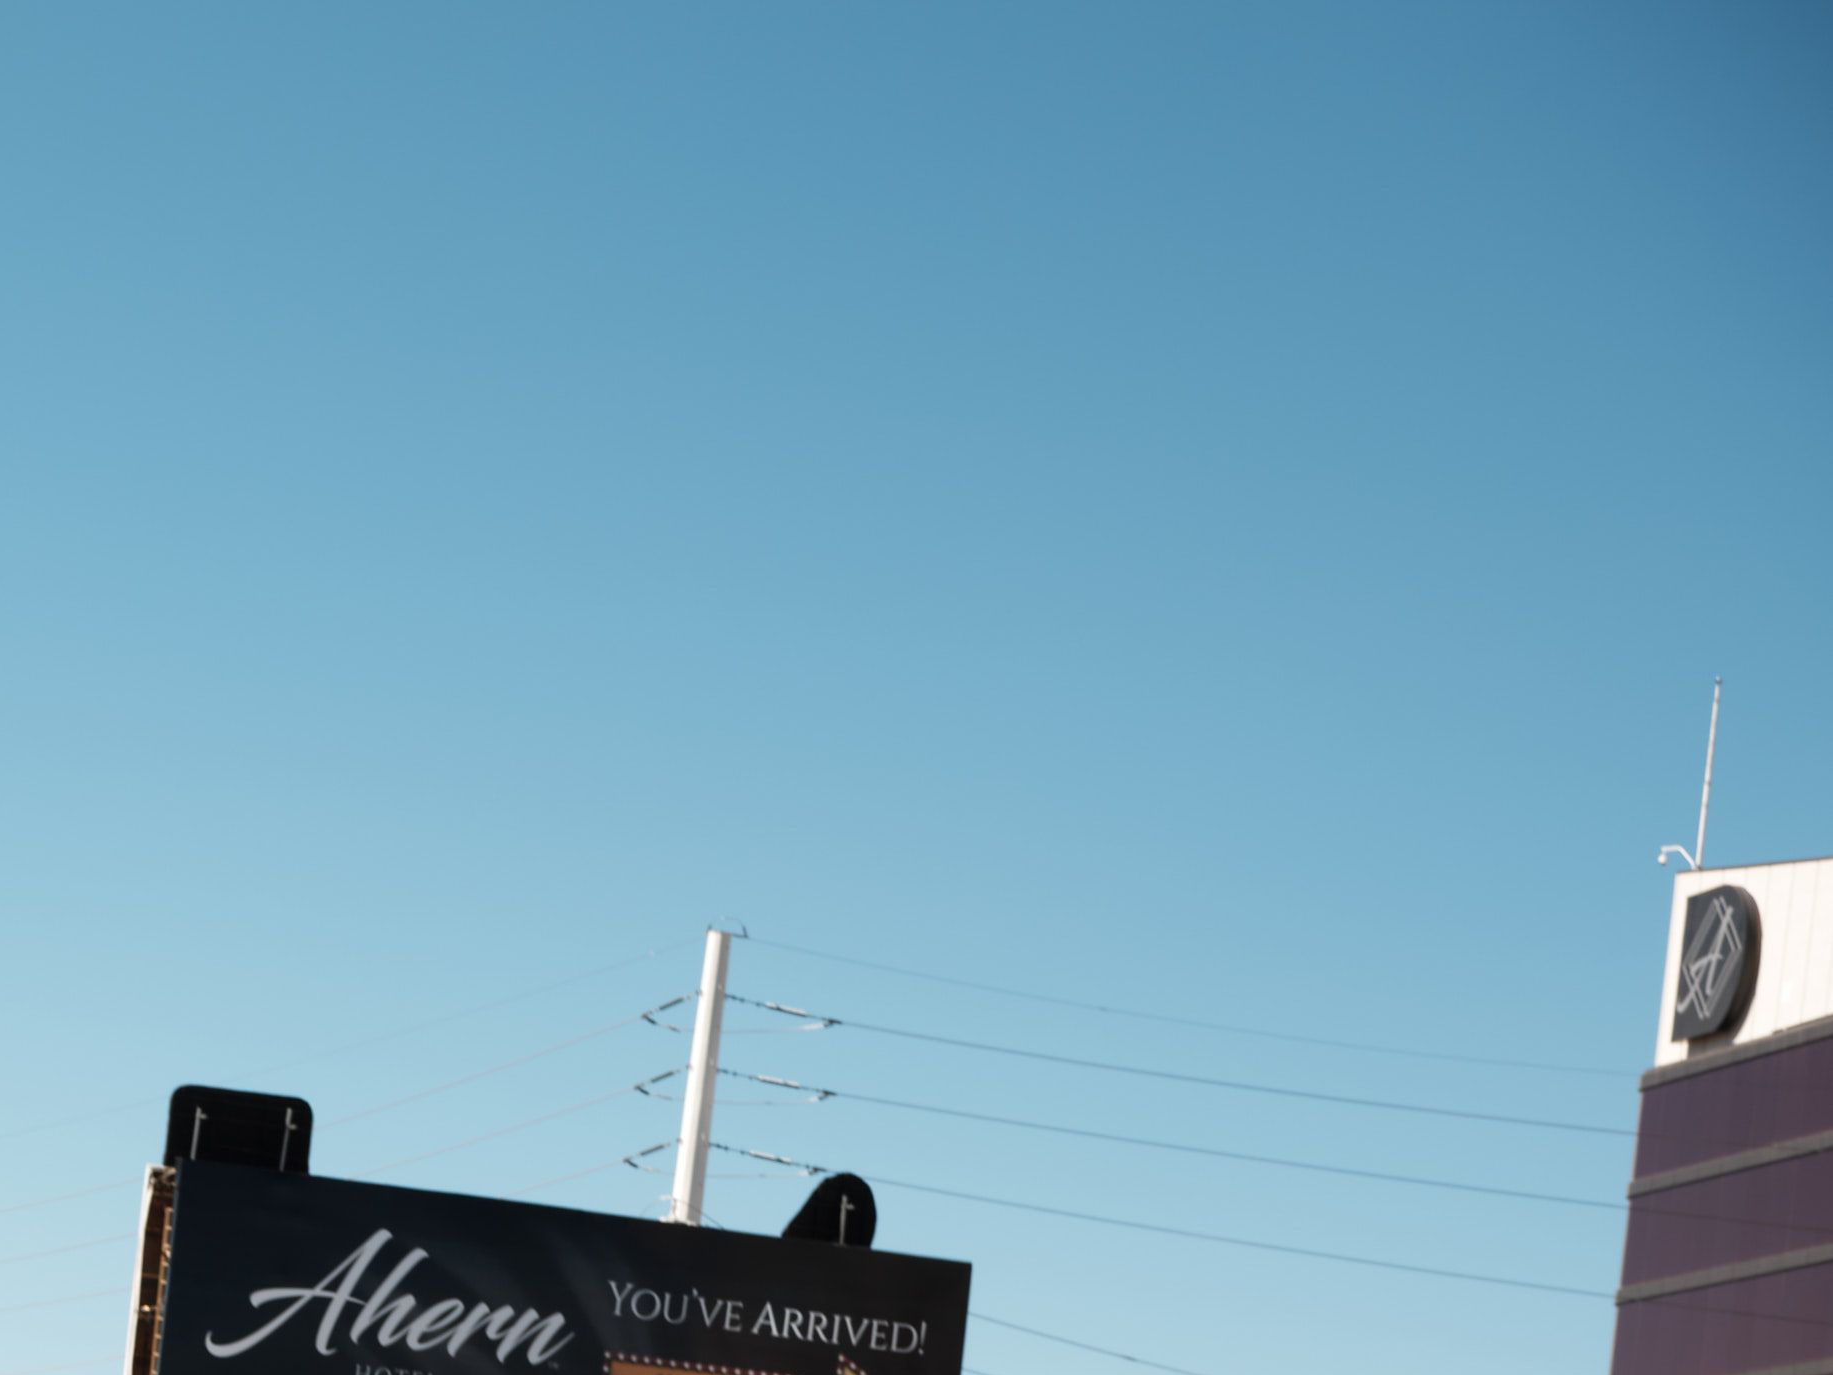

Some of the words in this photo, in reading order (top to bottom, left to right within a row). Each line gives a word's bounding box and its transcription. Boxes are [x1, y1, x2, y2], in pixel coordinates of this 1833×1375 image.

[205, 1228, 575, 1366] Ahern
[608, 1280, 744, 1332] YOU'VE
[751, 1301, 928, 1356] ARRIVED!
